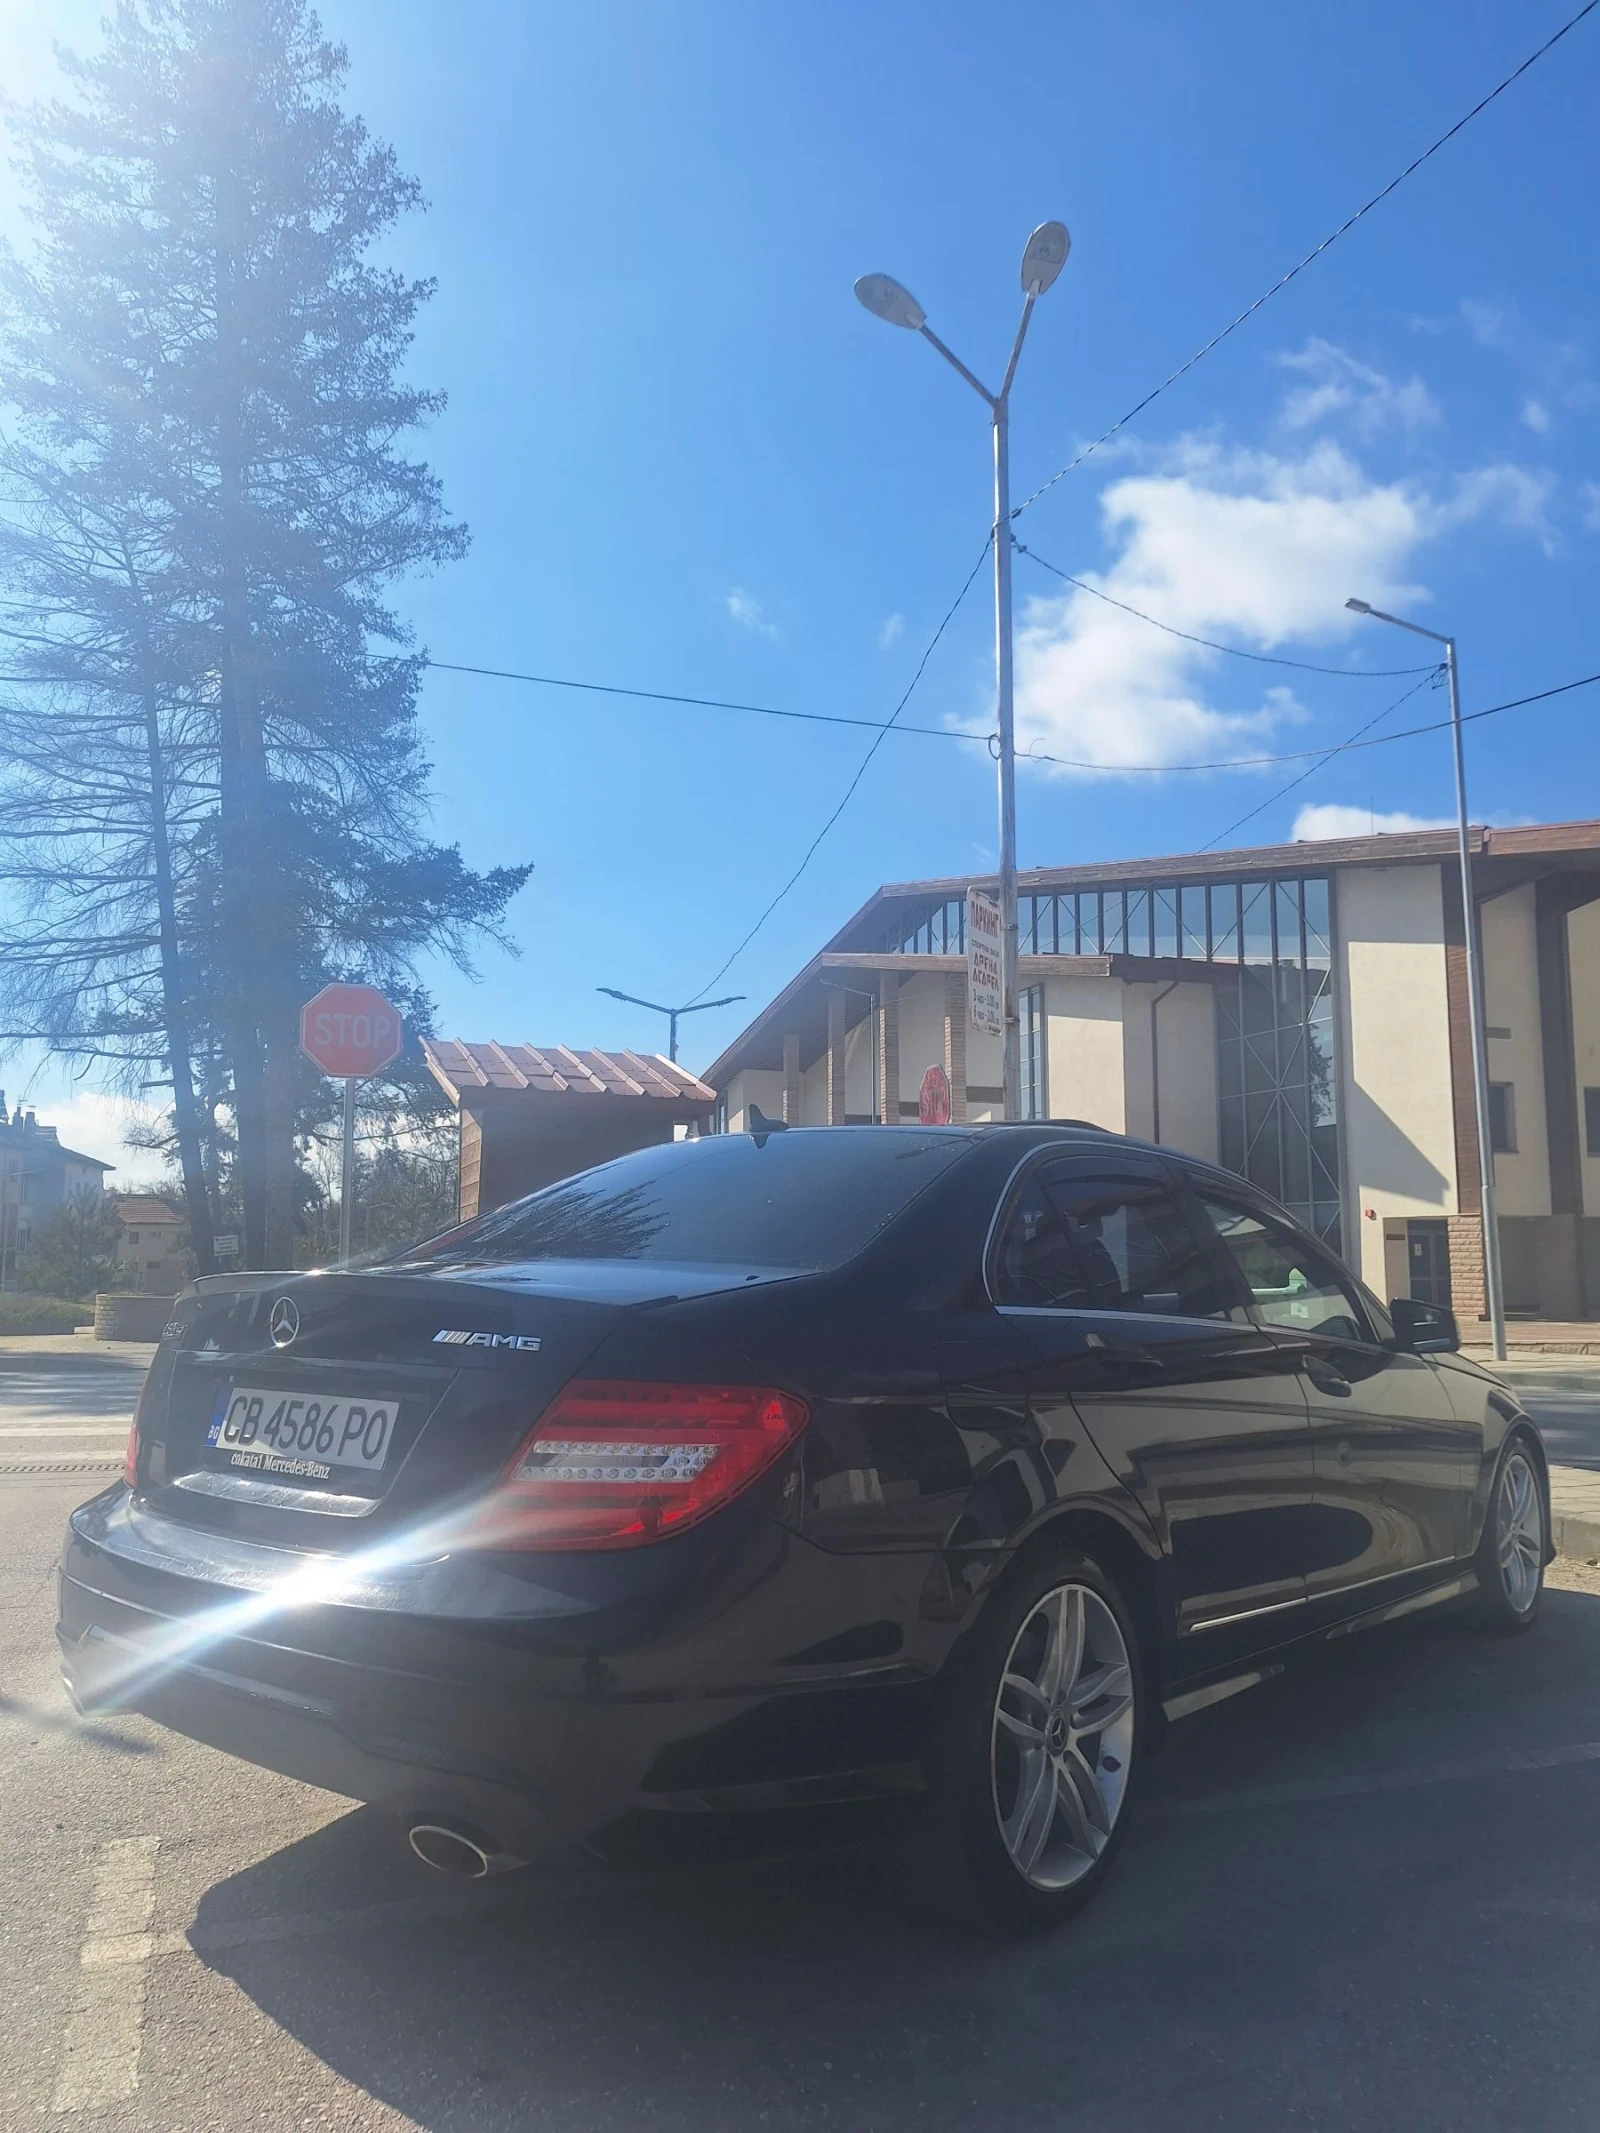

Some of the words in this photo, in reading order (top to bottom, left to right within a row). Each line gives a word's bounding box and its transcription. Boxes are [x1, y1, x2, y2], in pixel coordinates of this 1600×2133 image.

[971, 900, 998, 939] ПАРКИНГ
[974, 952, 998, 975] АРЕНА
[973, 988, 977, 1002] 3
[314, 1012, 391, 1049] STOP
[465, 1332, 541, 1352] AMG
[207, 1424, 220, 1440] BG
[224, 1395, 264, 1446] CB
[264, 1399, 340, 1454] 4586
[230, 1450, 262, 1469] cokata1
[263, 1455, 331, 1479] Mercedes-Benz
